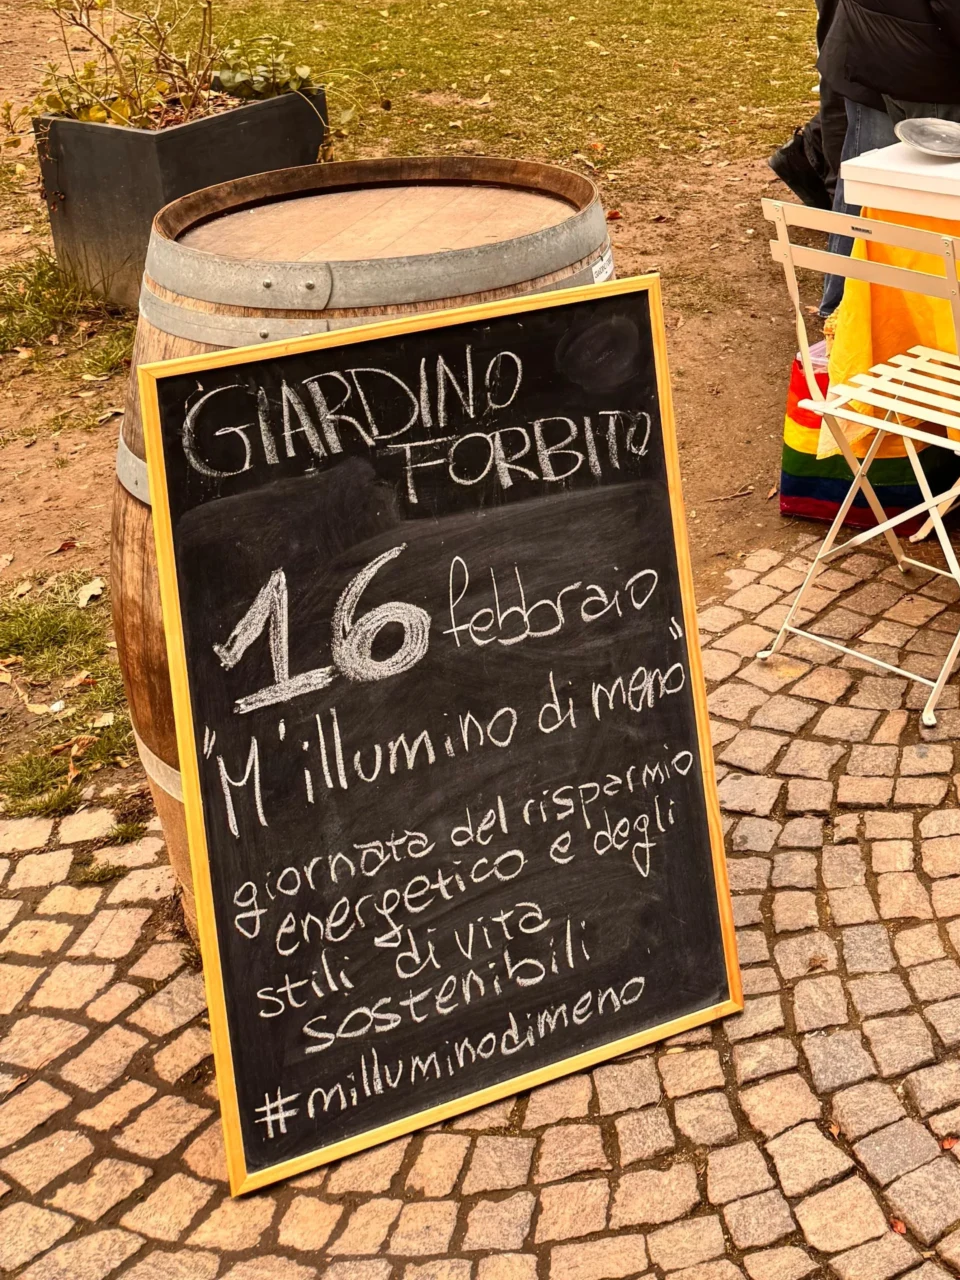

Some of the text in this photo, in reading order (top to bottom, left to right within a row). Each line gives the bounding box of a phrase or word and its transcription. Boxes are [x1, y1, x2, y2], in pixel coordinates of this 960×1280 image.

[182, 344, 523, 477] GIARDINO
[386, 410, 652, 504] FORBITO
[212, 544, 659, 715] 16 febbraio
[538, 670, 576, 734] di
[234, 744, 694, 939] giornata del risparmio
[276, 798, 676, 957] energetico e degli
[256, 901, 549, 1018] stili di vita
[303, 919, 590, 1055] sostenibili
[254, 976, 646, 1140] #milluminodimeno
